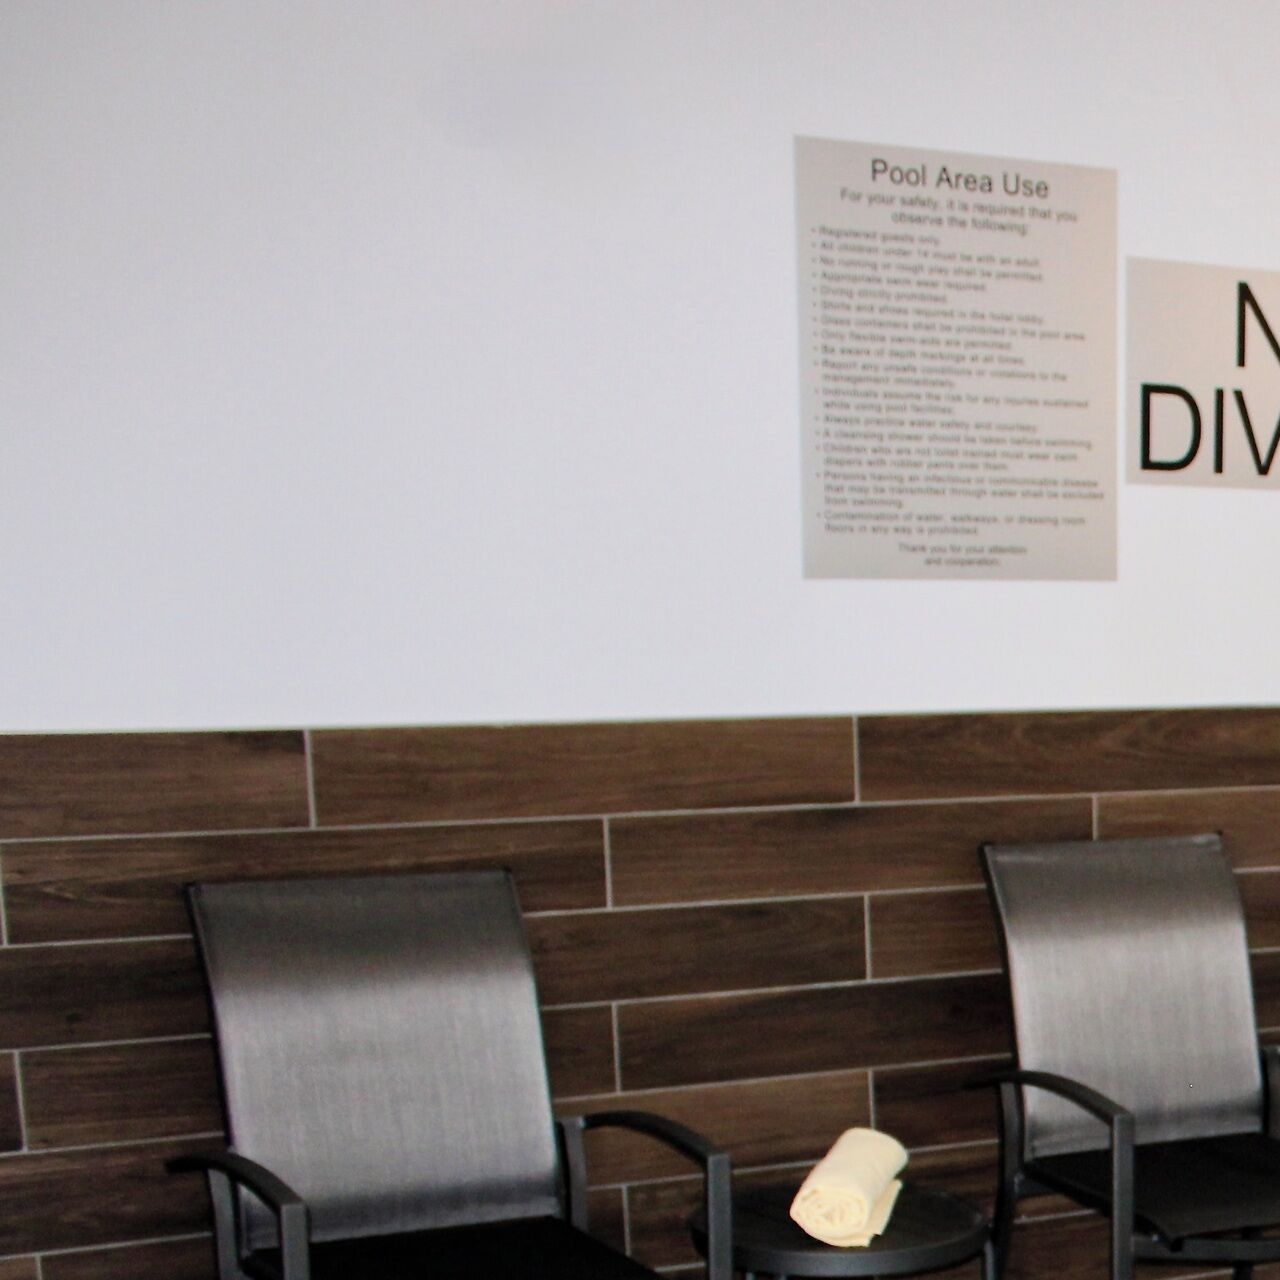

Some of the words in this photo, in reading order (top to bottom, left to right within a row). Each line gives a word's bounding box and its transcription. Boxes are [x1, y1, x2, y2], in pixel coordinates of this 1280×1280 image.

[870, 158, 927, 187] Pool
[934, 166, 994, 193] Area
[1002, 172, 1050, 199] Use
[840, 187, 862, 202] For
[867, 192, 895, 206] your
[946, 198, 954, 211] it
[958, 201, 969, 212] is
[972, 202, 1025, 217] required
[1028, 206, 1052, 220] that
[1056, 210, 1077, 223] you
[891, 212, 943, 226] observe
[947, 216, 967, 228] the
